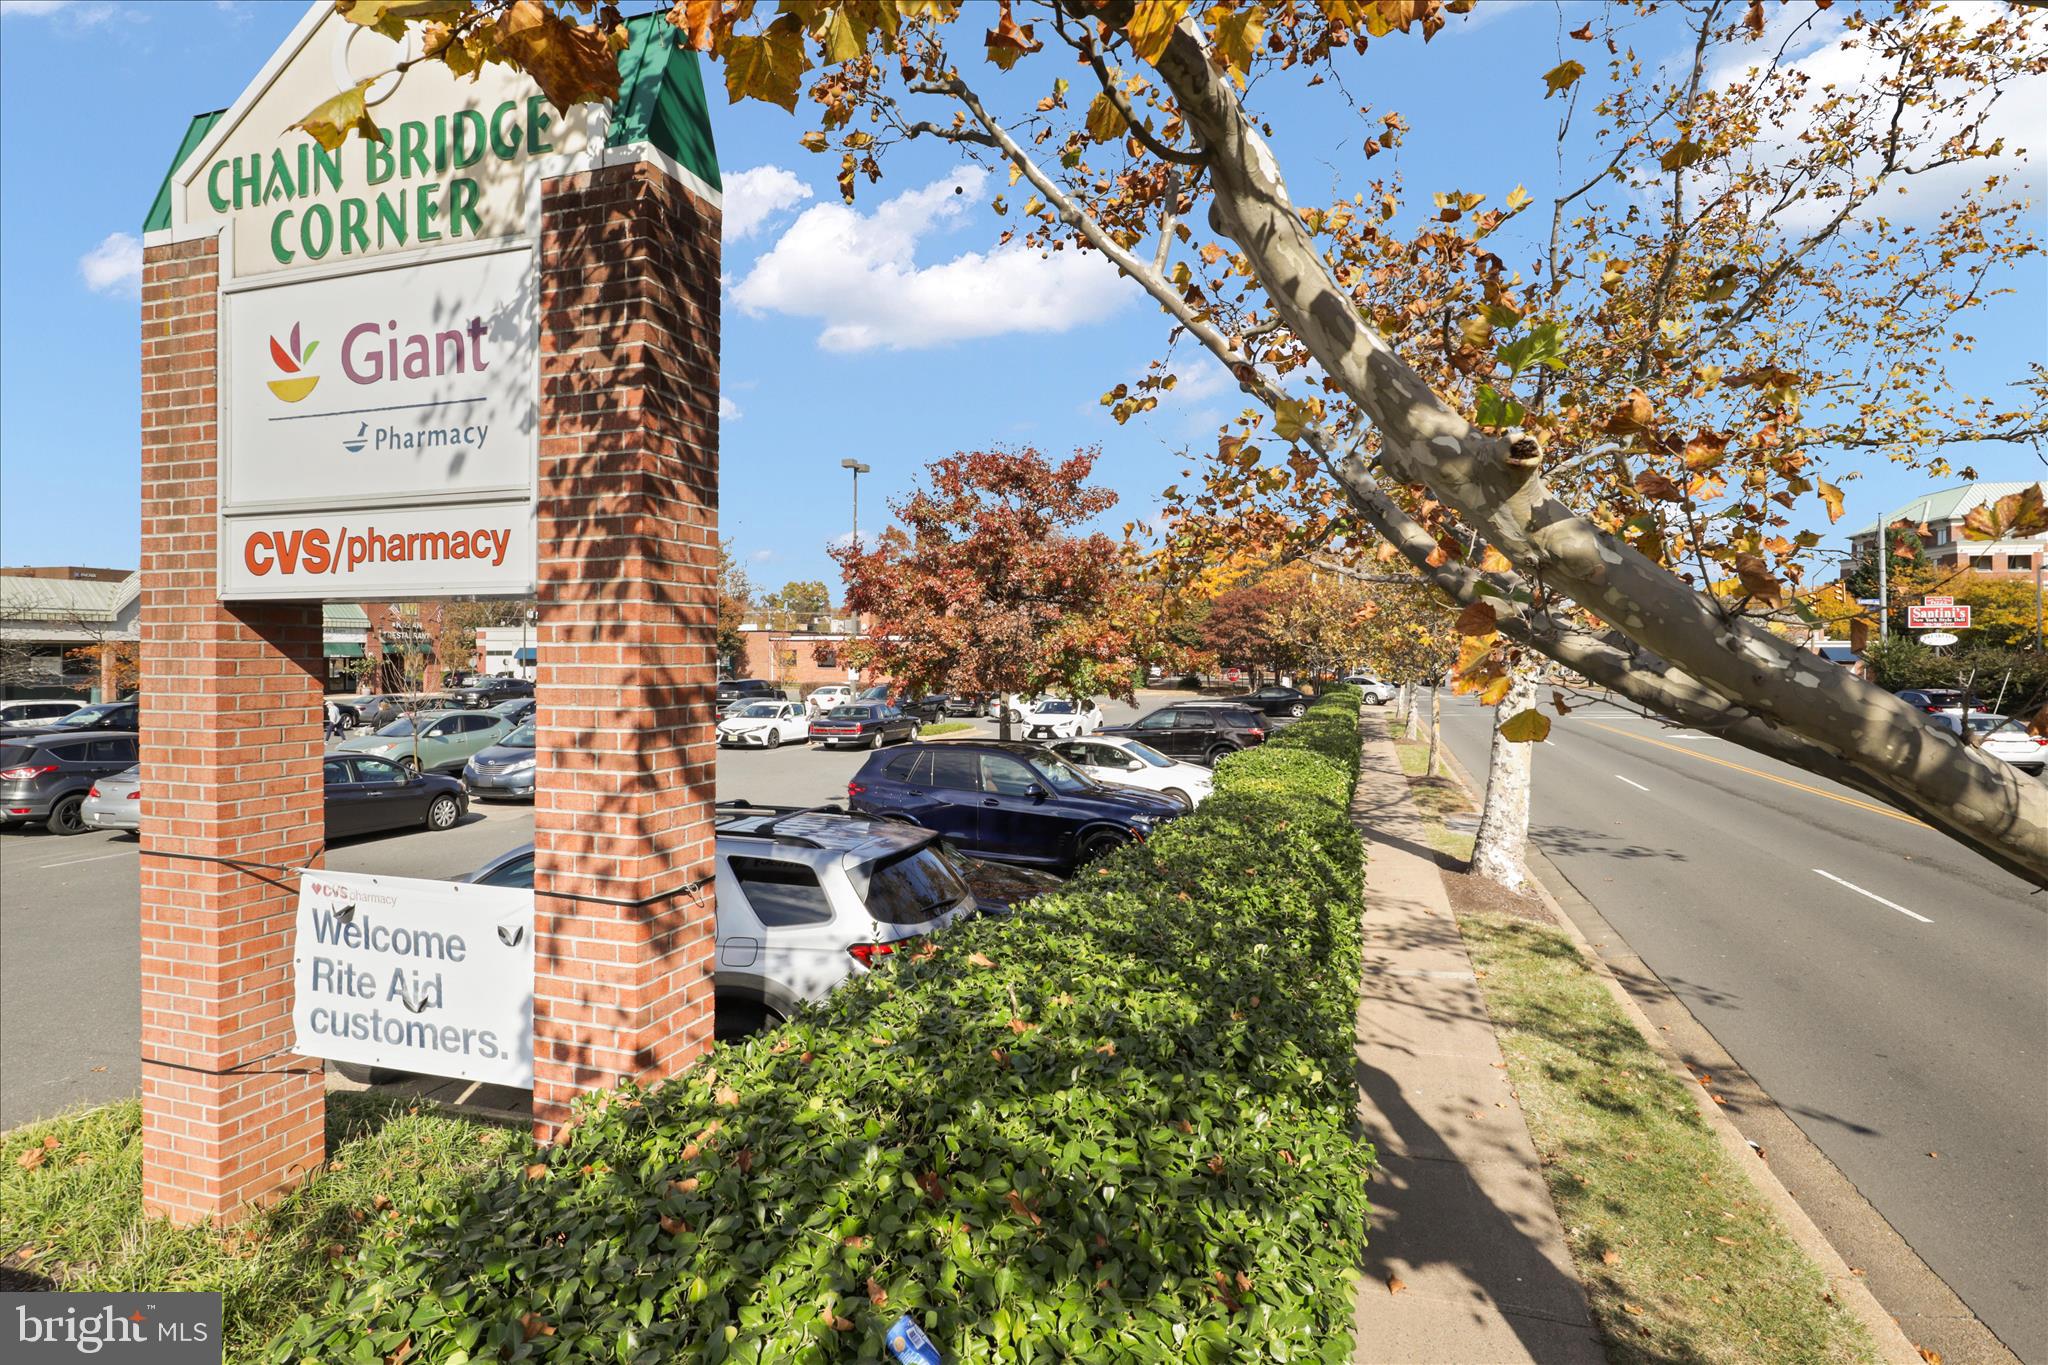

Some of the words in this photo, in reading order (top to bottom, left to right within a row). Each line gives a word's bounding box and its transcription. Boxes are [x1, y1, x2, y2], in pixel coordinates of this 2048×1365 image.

[208, 141, 344, 213] CHAIN
[366, 94, 555, 186] BRIDGE
[270, 177, 484, 264] CORNER
[341, 315, 489, 386] Giant
[375, 422, 489, 451] Pharmacy
[244, 526, 512, 577] CVS/pharmacy
[1912, 607, 1966, 618] Santini's
[323, 884, 348, 899] CVS
[349, 889, 397, 907] pharmacy
[312, 907, 467, 963] Welcome
[312, 956, 377, 1000] Rite
[386, 967, 444, 1009] Aid
[310, 1006, 509, 1060] customers.
